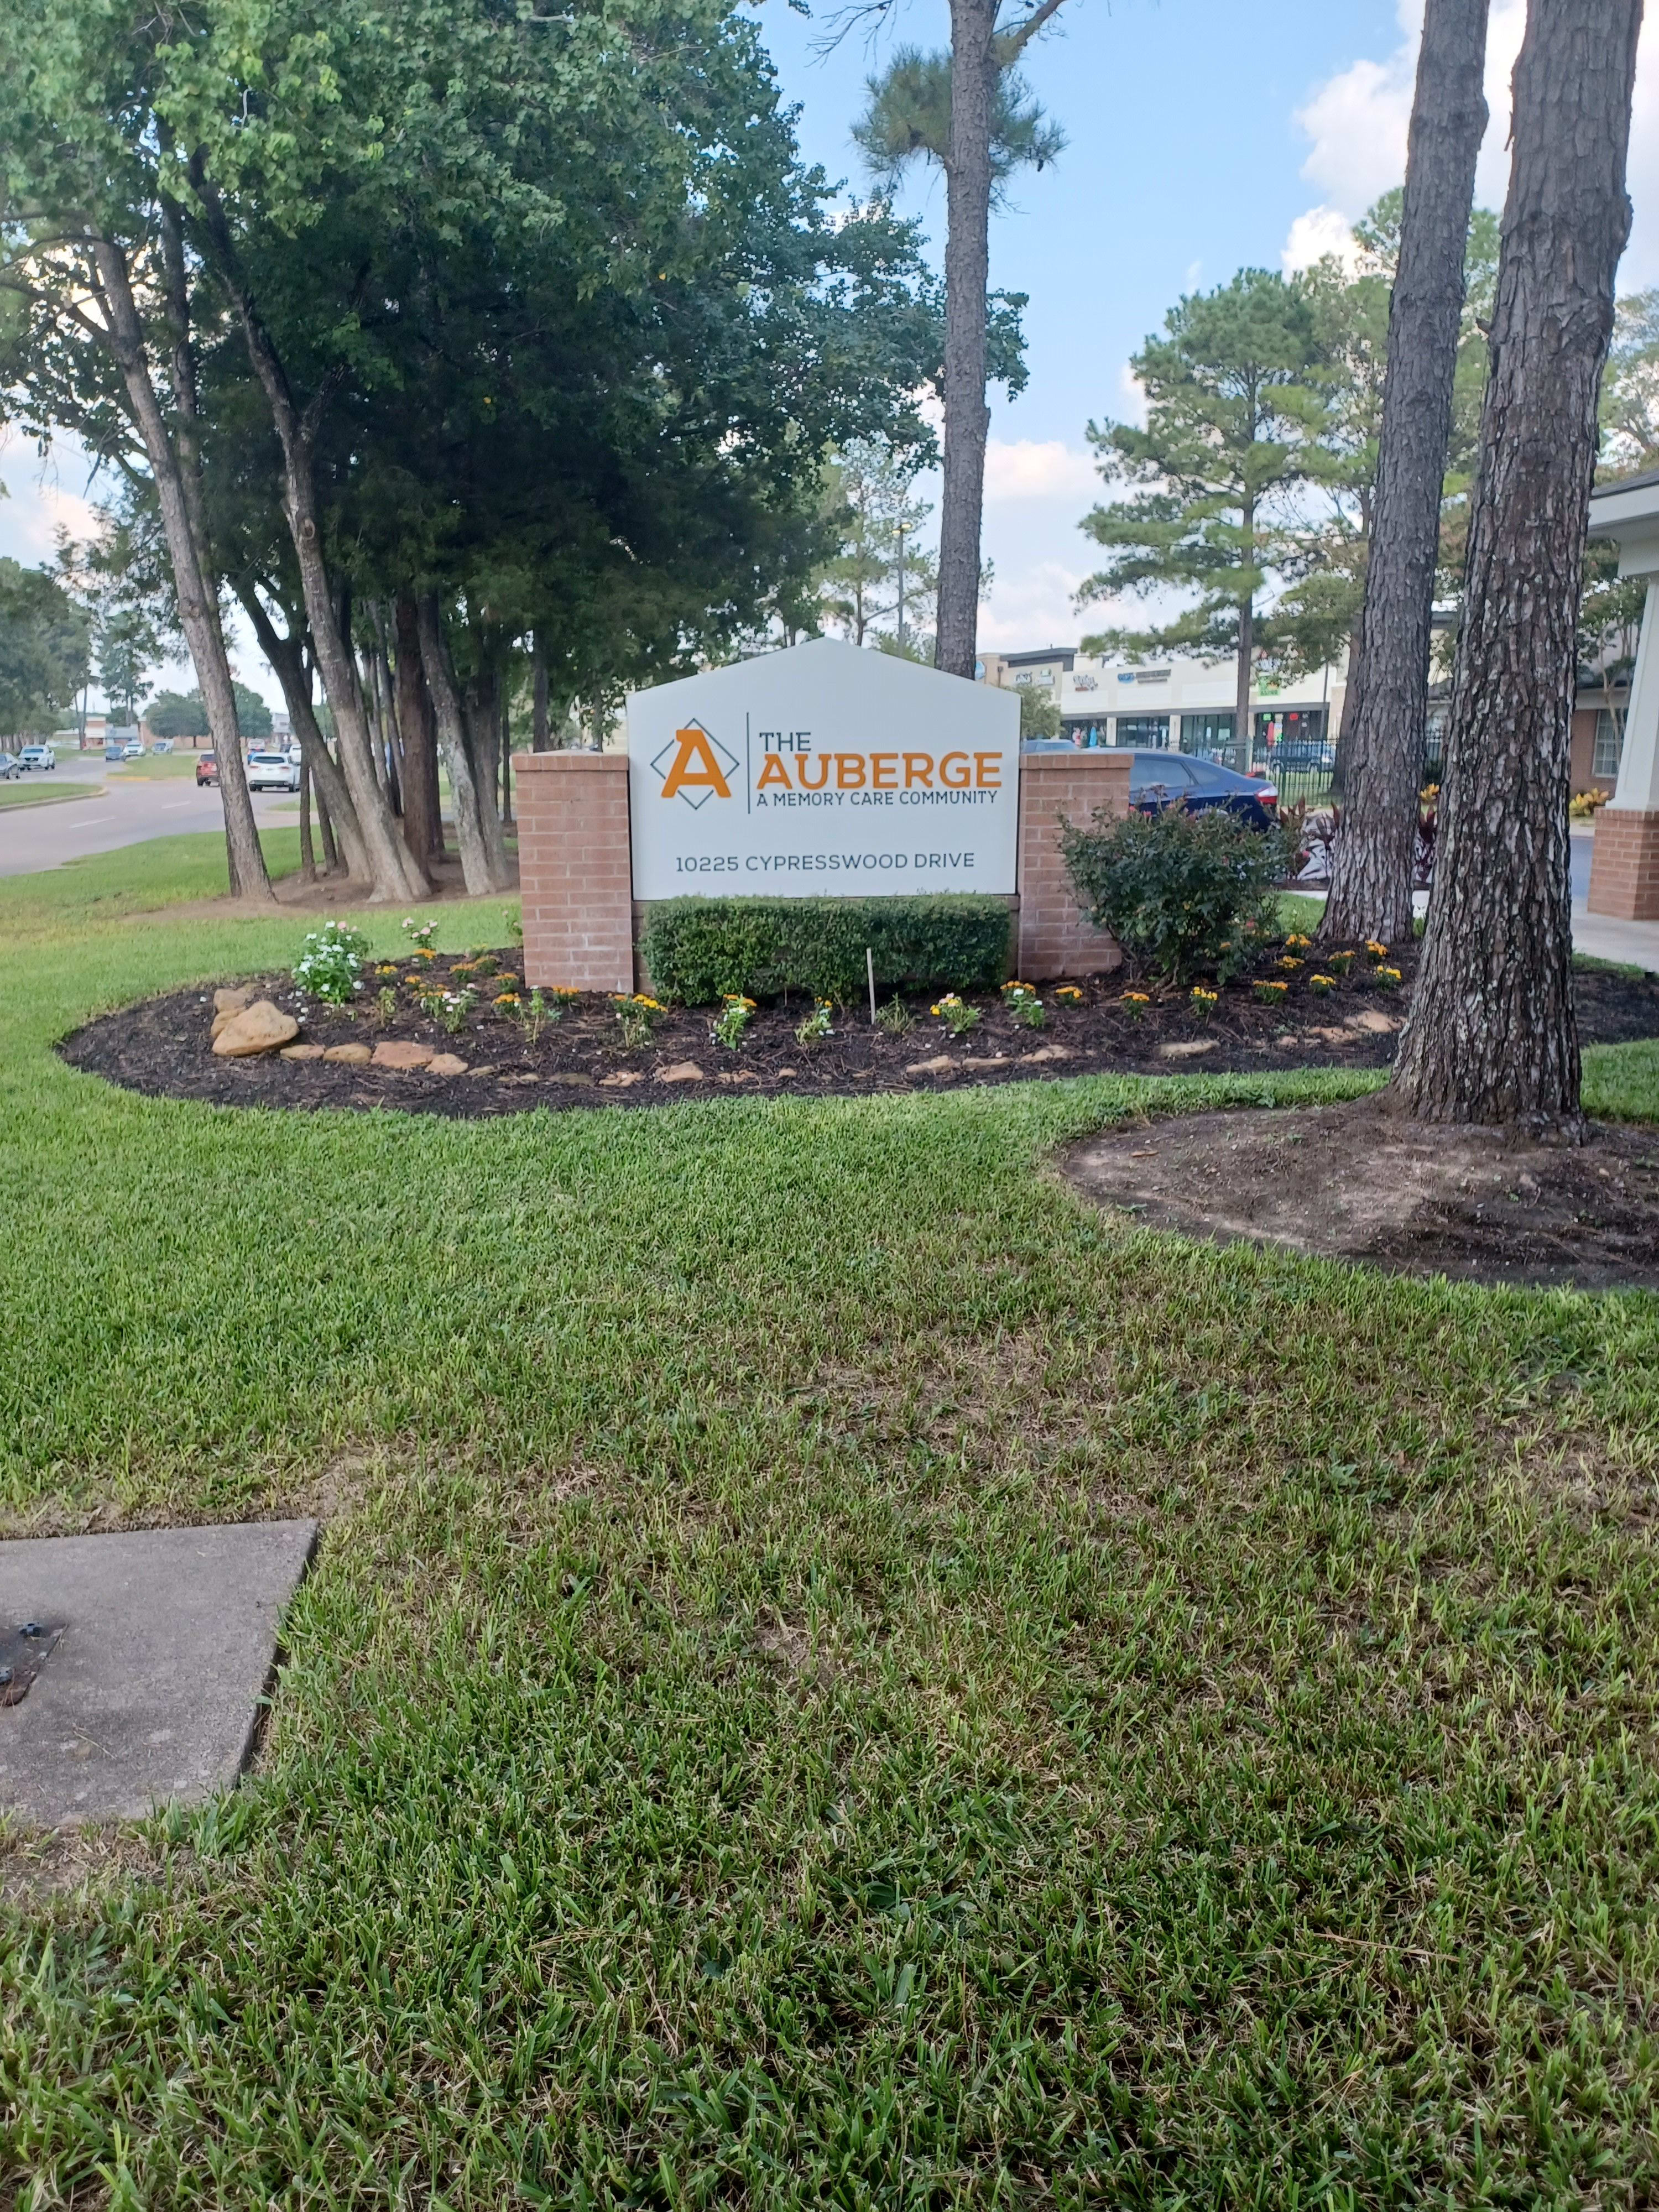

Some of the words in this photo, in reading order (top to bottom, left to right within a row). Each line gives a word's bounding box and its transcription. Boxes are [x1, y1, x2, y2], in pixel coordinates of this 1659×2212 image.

[759, 732, 811, 752] THE
[757, 752, 1003, 790] AUBERGE
[757, 793, 768, 807] A
[773, 792, 844, 806] MEMORY
[850, 791, 894, 805] CARE
[899, 790, 998, 805] COMMUNITY
[676, 856, 739, 872] 10225
[745, 853, 908, 871] CYPRESSWOOD
[915, 852, 975, 868] DRIVE
